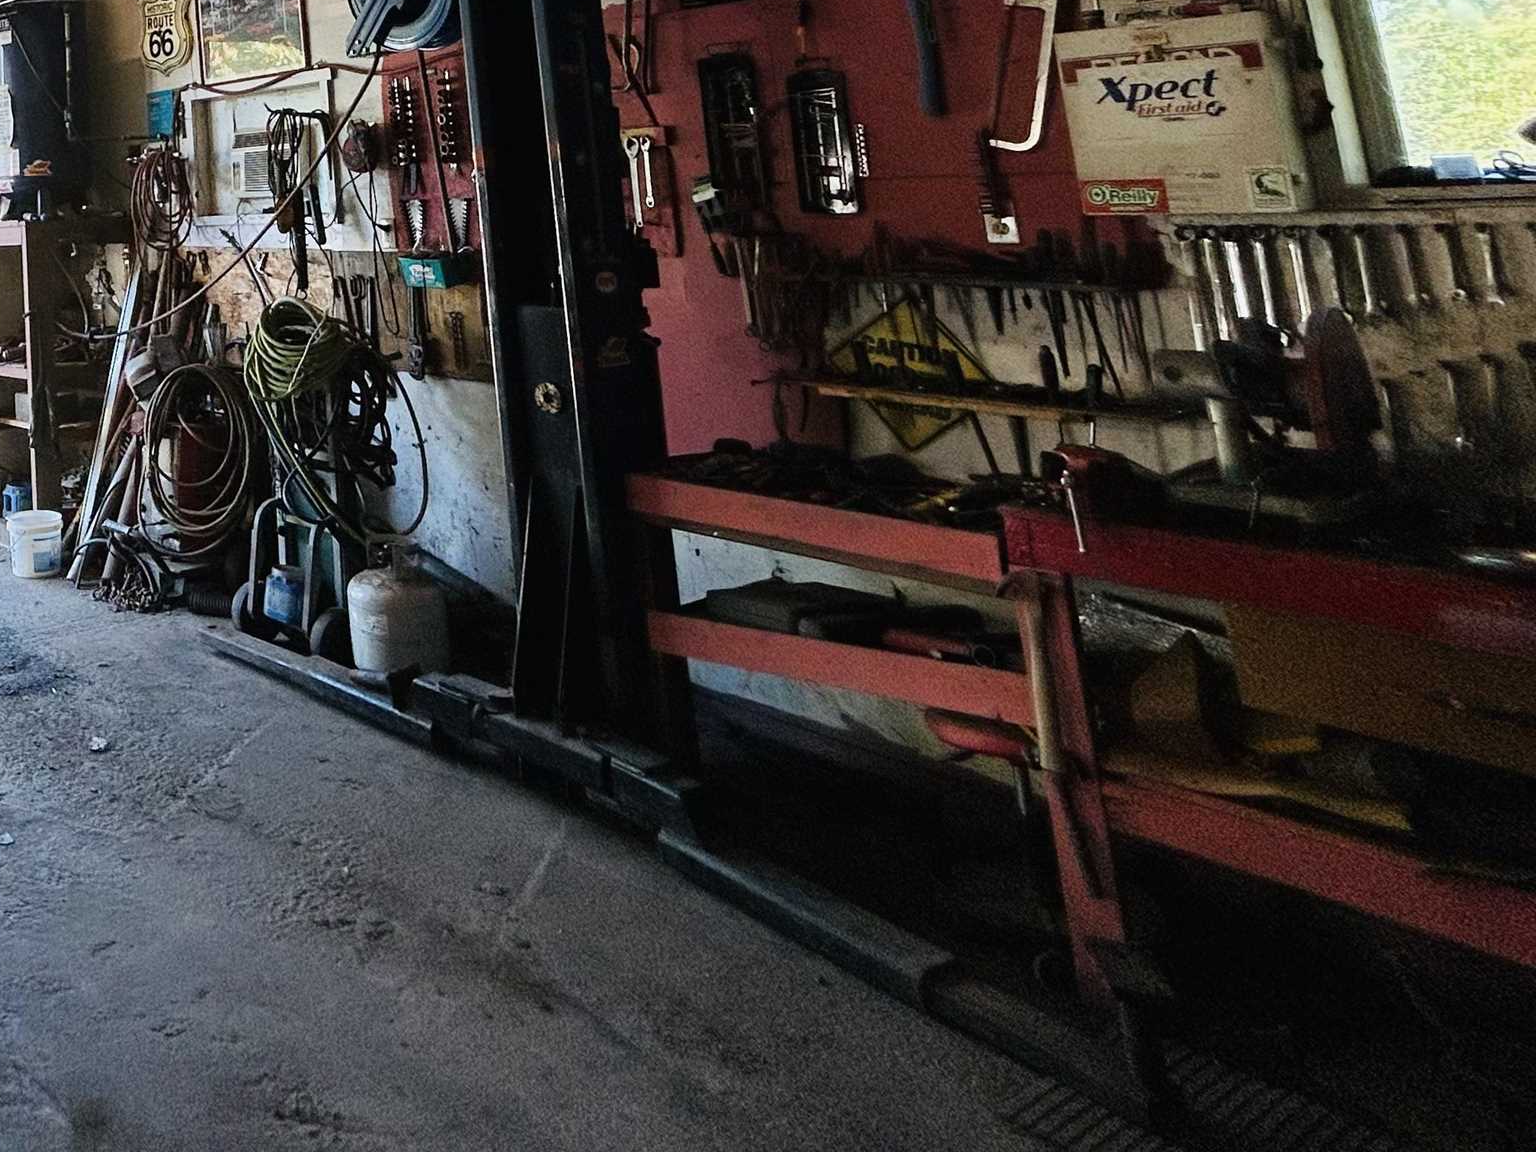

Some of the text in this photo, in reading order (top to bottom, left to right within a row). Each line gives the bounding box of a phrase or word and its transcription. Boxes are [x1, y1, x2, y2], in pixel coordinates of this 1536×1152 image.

[147, 15, 174, 29] ROUTE
[149, 29, 174, 58] 66
[1096, 69, 1220, 112] Xpect
[1137, 99, 1203, 116] First aid
[1088, 184, 1160, 205] O'Reilly
